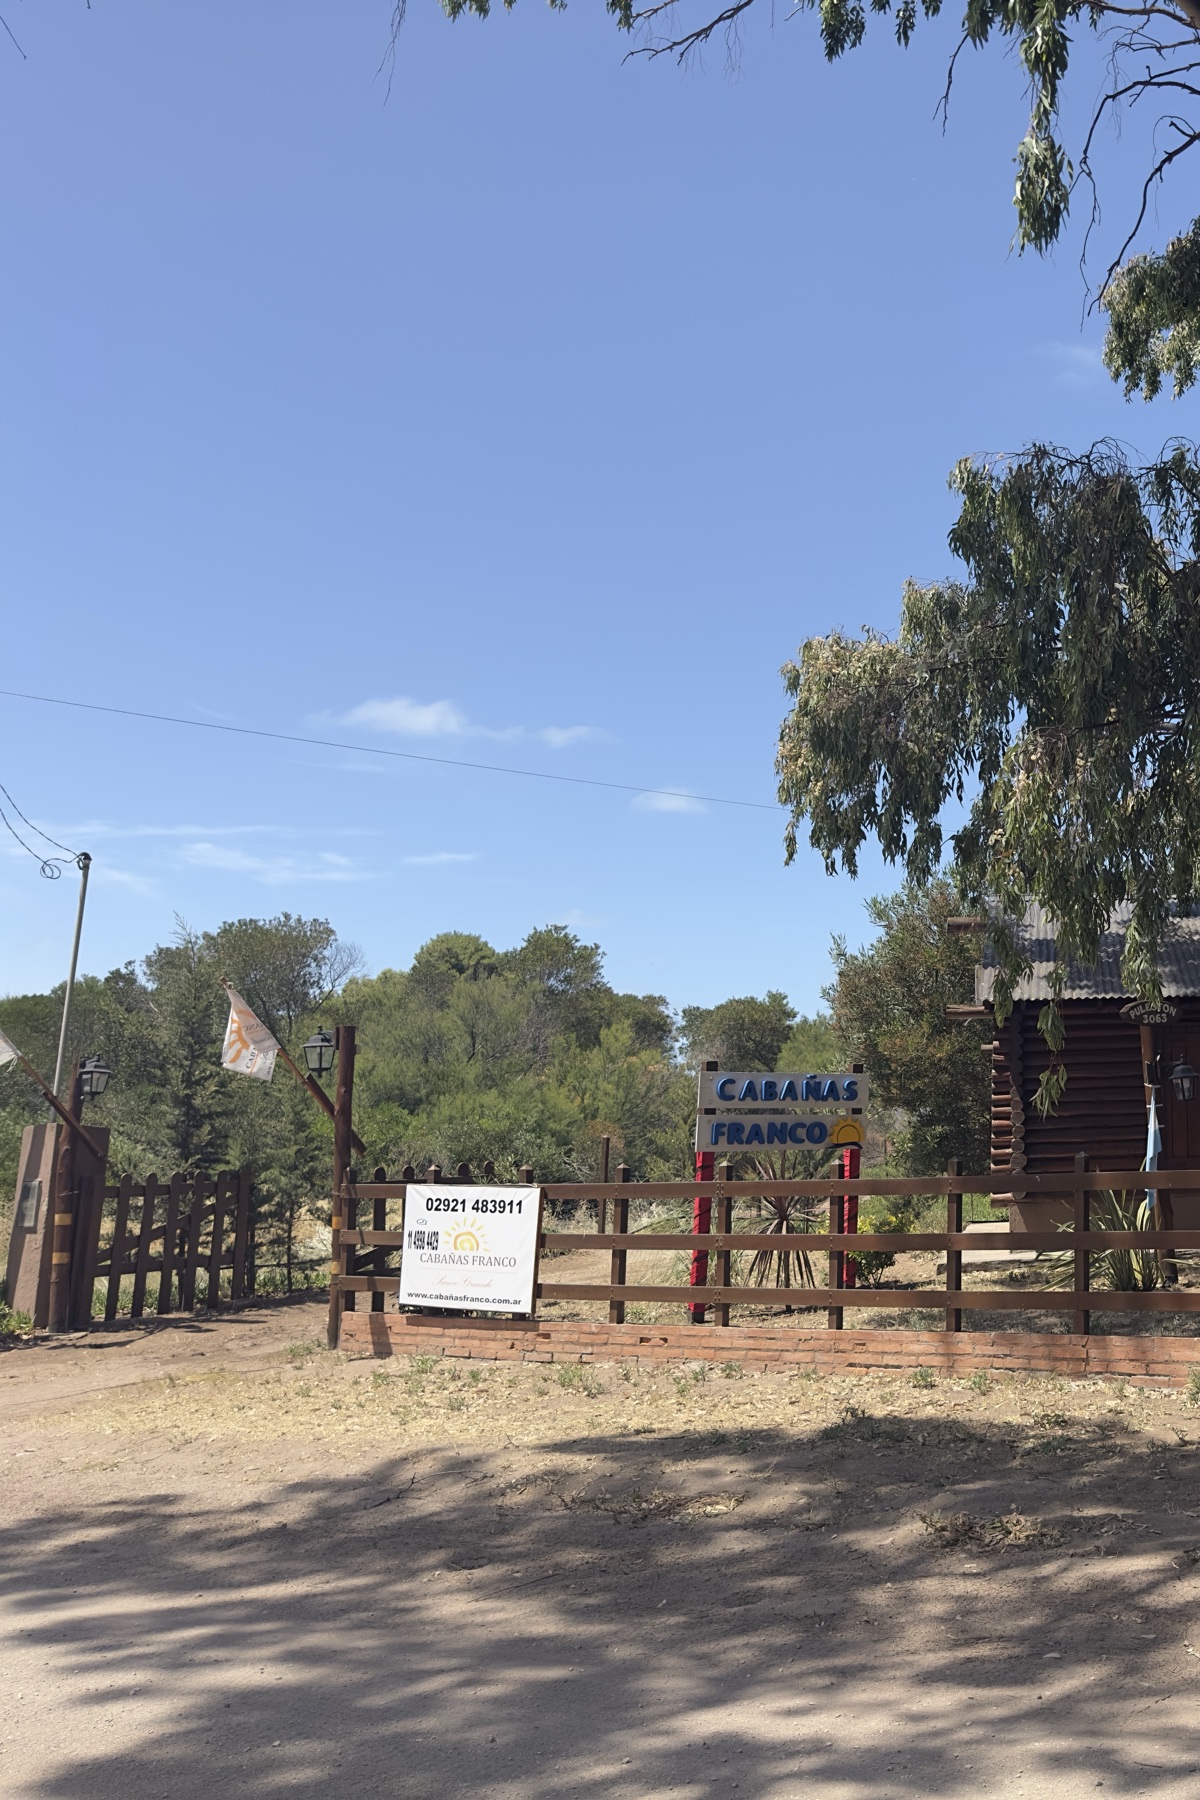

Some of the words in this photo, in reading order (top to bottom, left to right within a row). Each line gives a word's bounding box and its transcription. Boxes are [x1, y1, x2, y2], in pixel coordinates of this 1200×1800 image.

[1142, 1013, 1168, 1024] 3063
[716, 1074, 859, 1102] CABAÑAS
[710, 1122, 828, 1145] FRANCO
[425, 1197, 466, 1213] 02921
[471, 1199, 523, 1214] 483911
[407, 1230, 413, 1250] 11
[419, 1252, 469, 1266] CABAÑAS
[472, 1255, 517, 1268] FRANCO
[407, 1291, 522, 1306] www.cabañasfranco.com.ar
